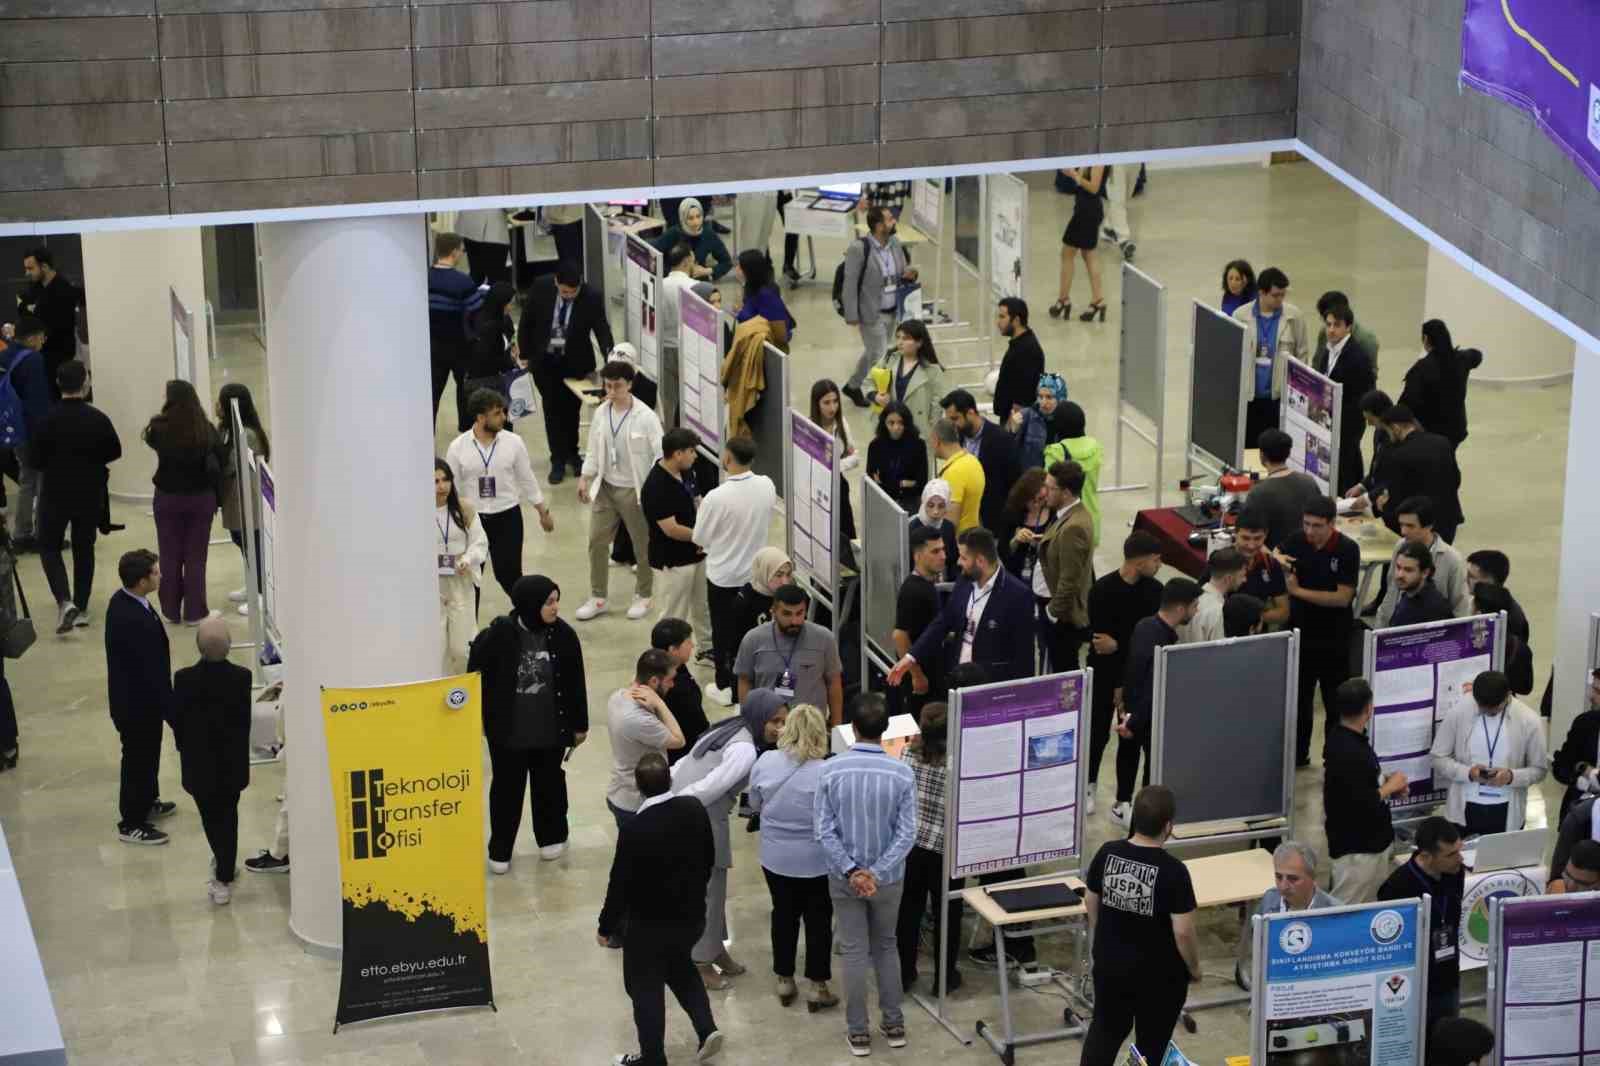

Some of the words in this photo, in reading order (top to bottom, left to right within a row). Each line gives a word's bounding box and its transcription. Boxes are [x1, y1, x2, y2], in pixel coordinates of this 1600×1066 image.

[374, 769, 471, 798] Teknoloji
[374, 799, 463, 824] Transfer
[377, 828, 423, 850] Ofisi
[1107, 857, 1155, 886] AUTHENTIC
[1110, 877, 1144, 897] USPA
[360, 953, 468, 978] etto.ebyu.edu.tr
